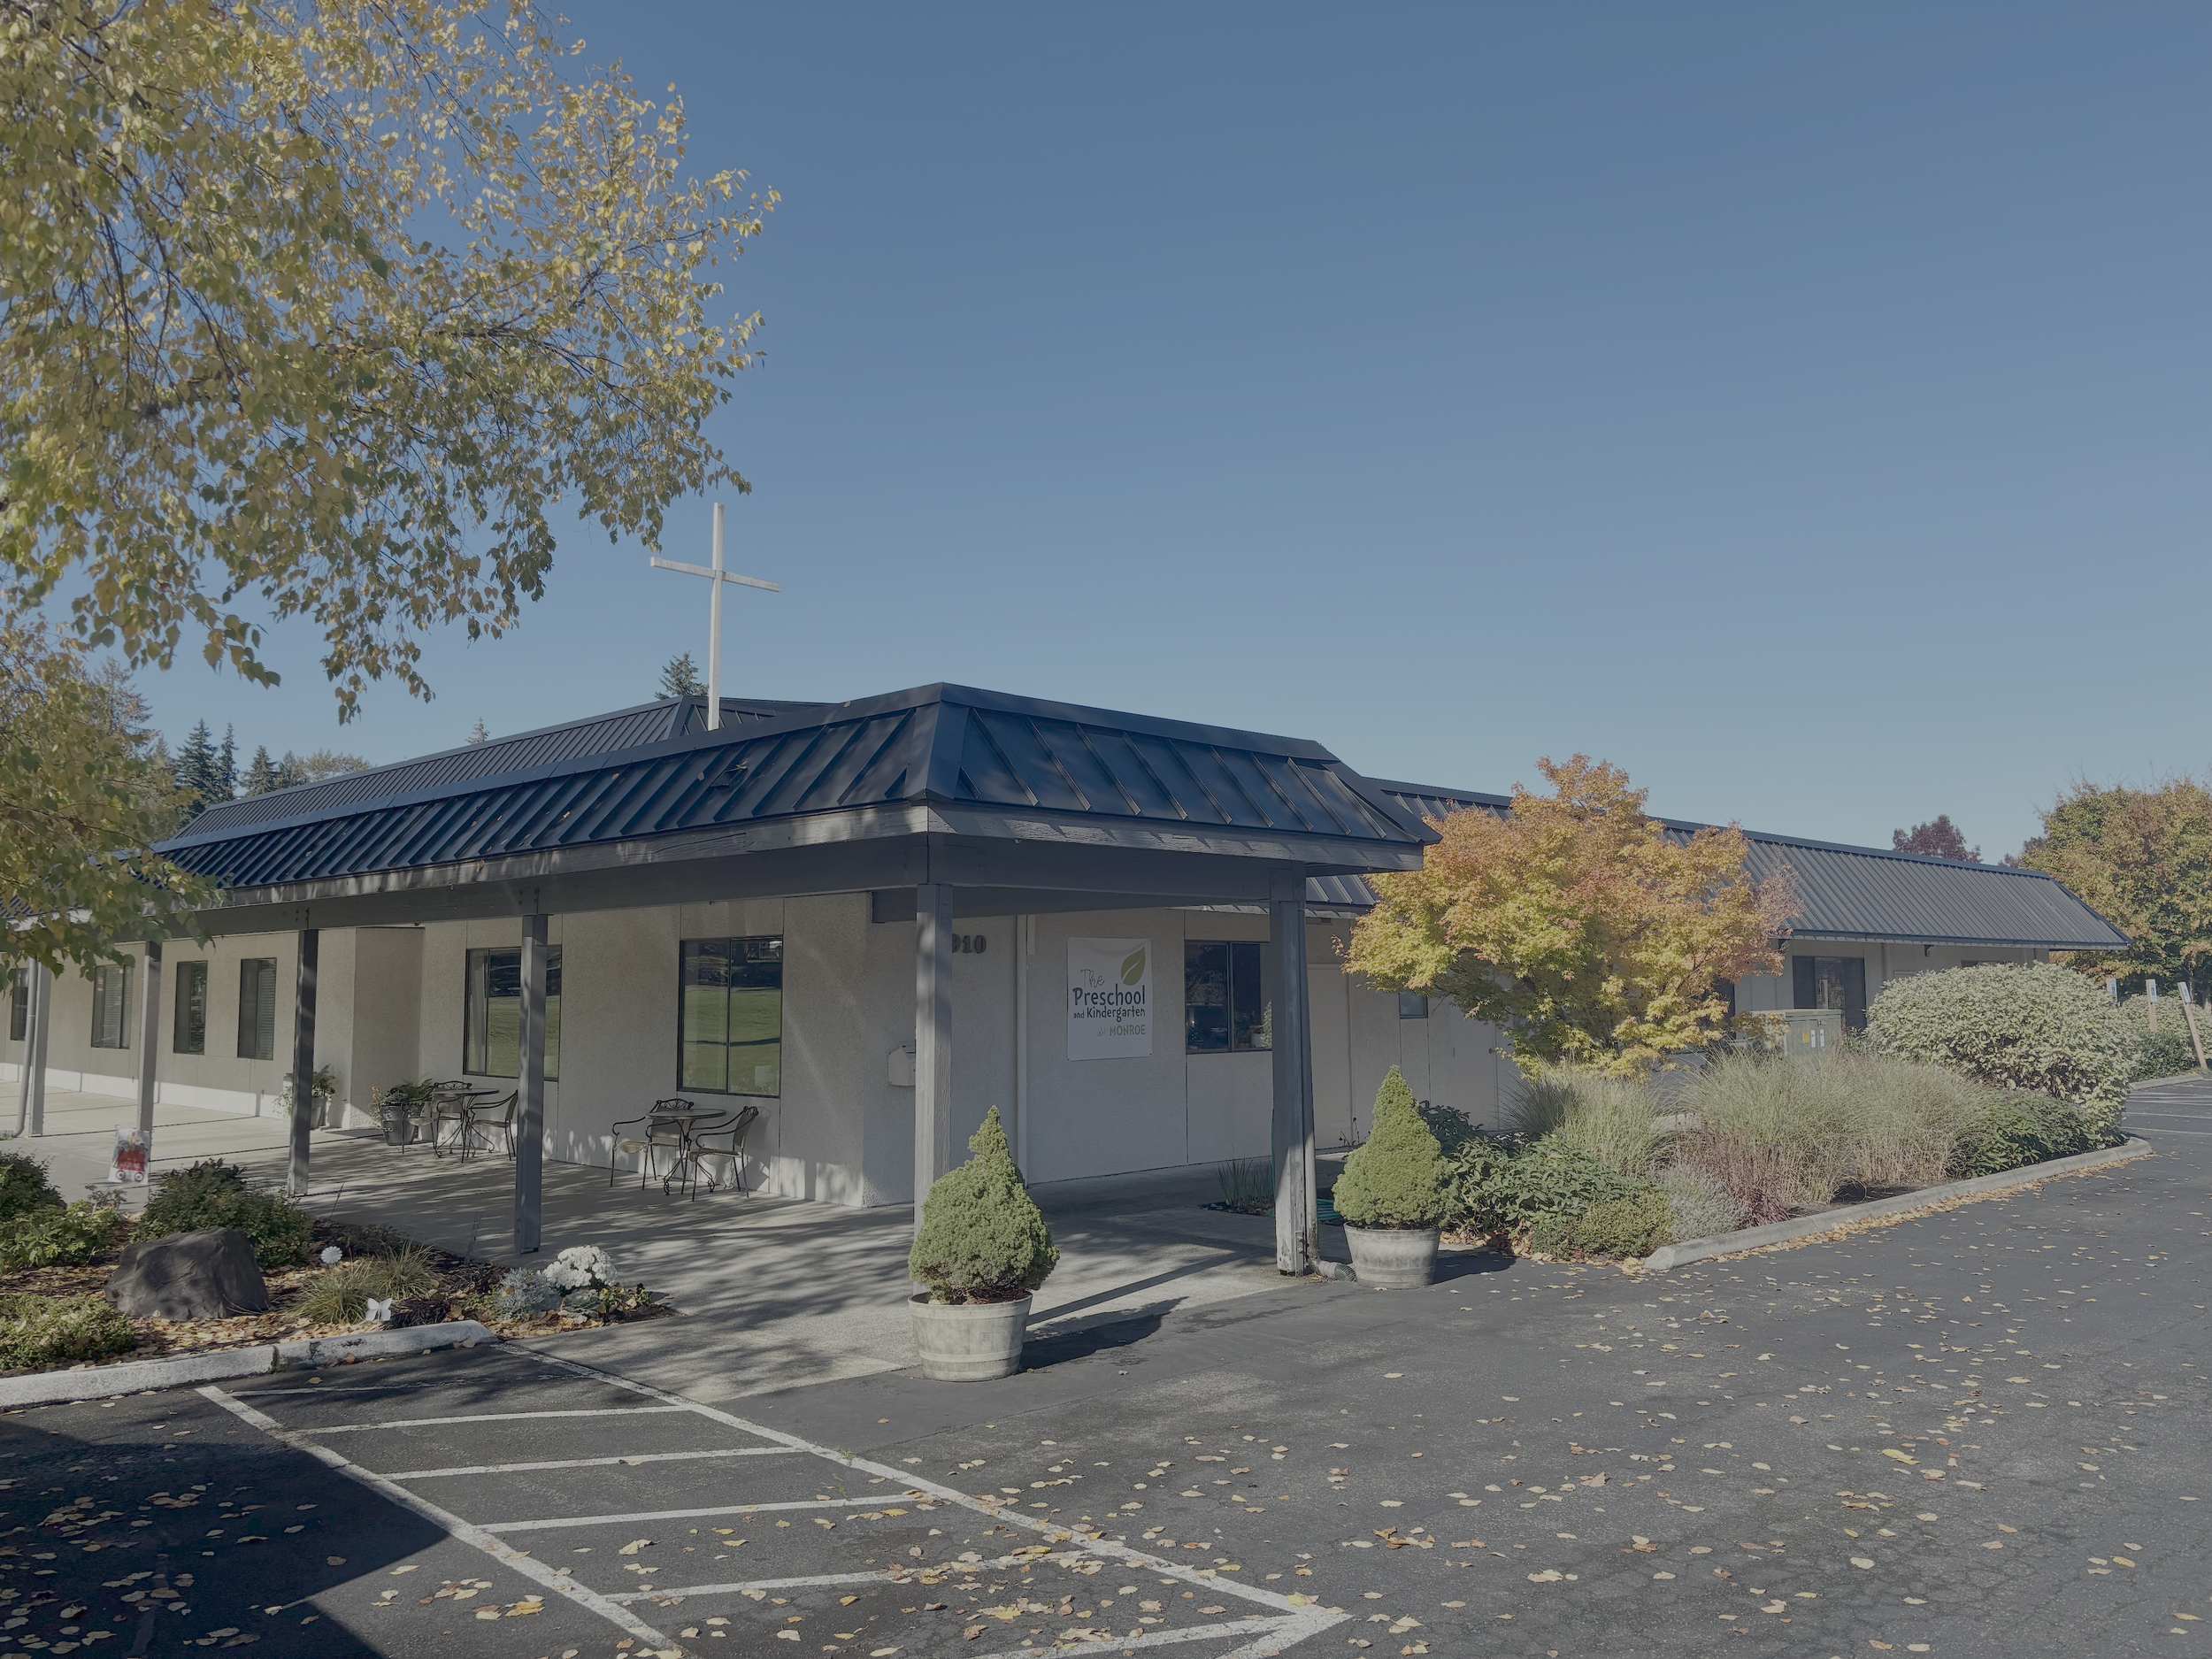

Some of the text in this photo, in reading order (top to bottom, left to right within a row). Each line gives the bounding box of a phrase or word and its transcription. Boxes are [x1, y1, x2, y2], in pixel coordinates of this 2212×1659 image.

[1079, 968, 1105, 988] The
[1072, 983, 1145, 1006] Preschool
[1072, 1005, 1146, 1022] and Kindergarten
[1097, 1025, 1146, 1037] at MONROE
